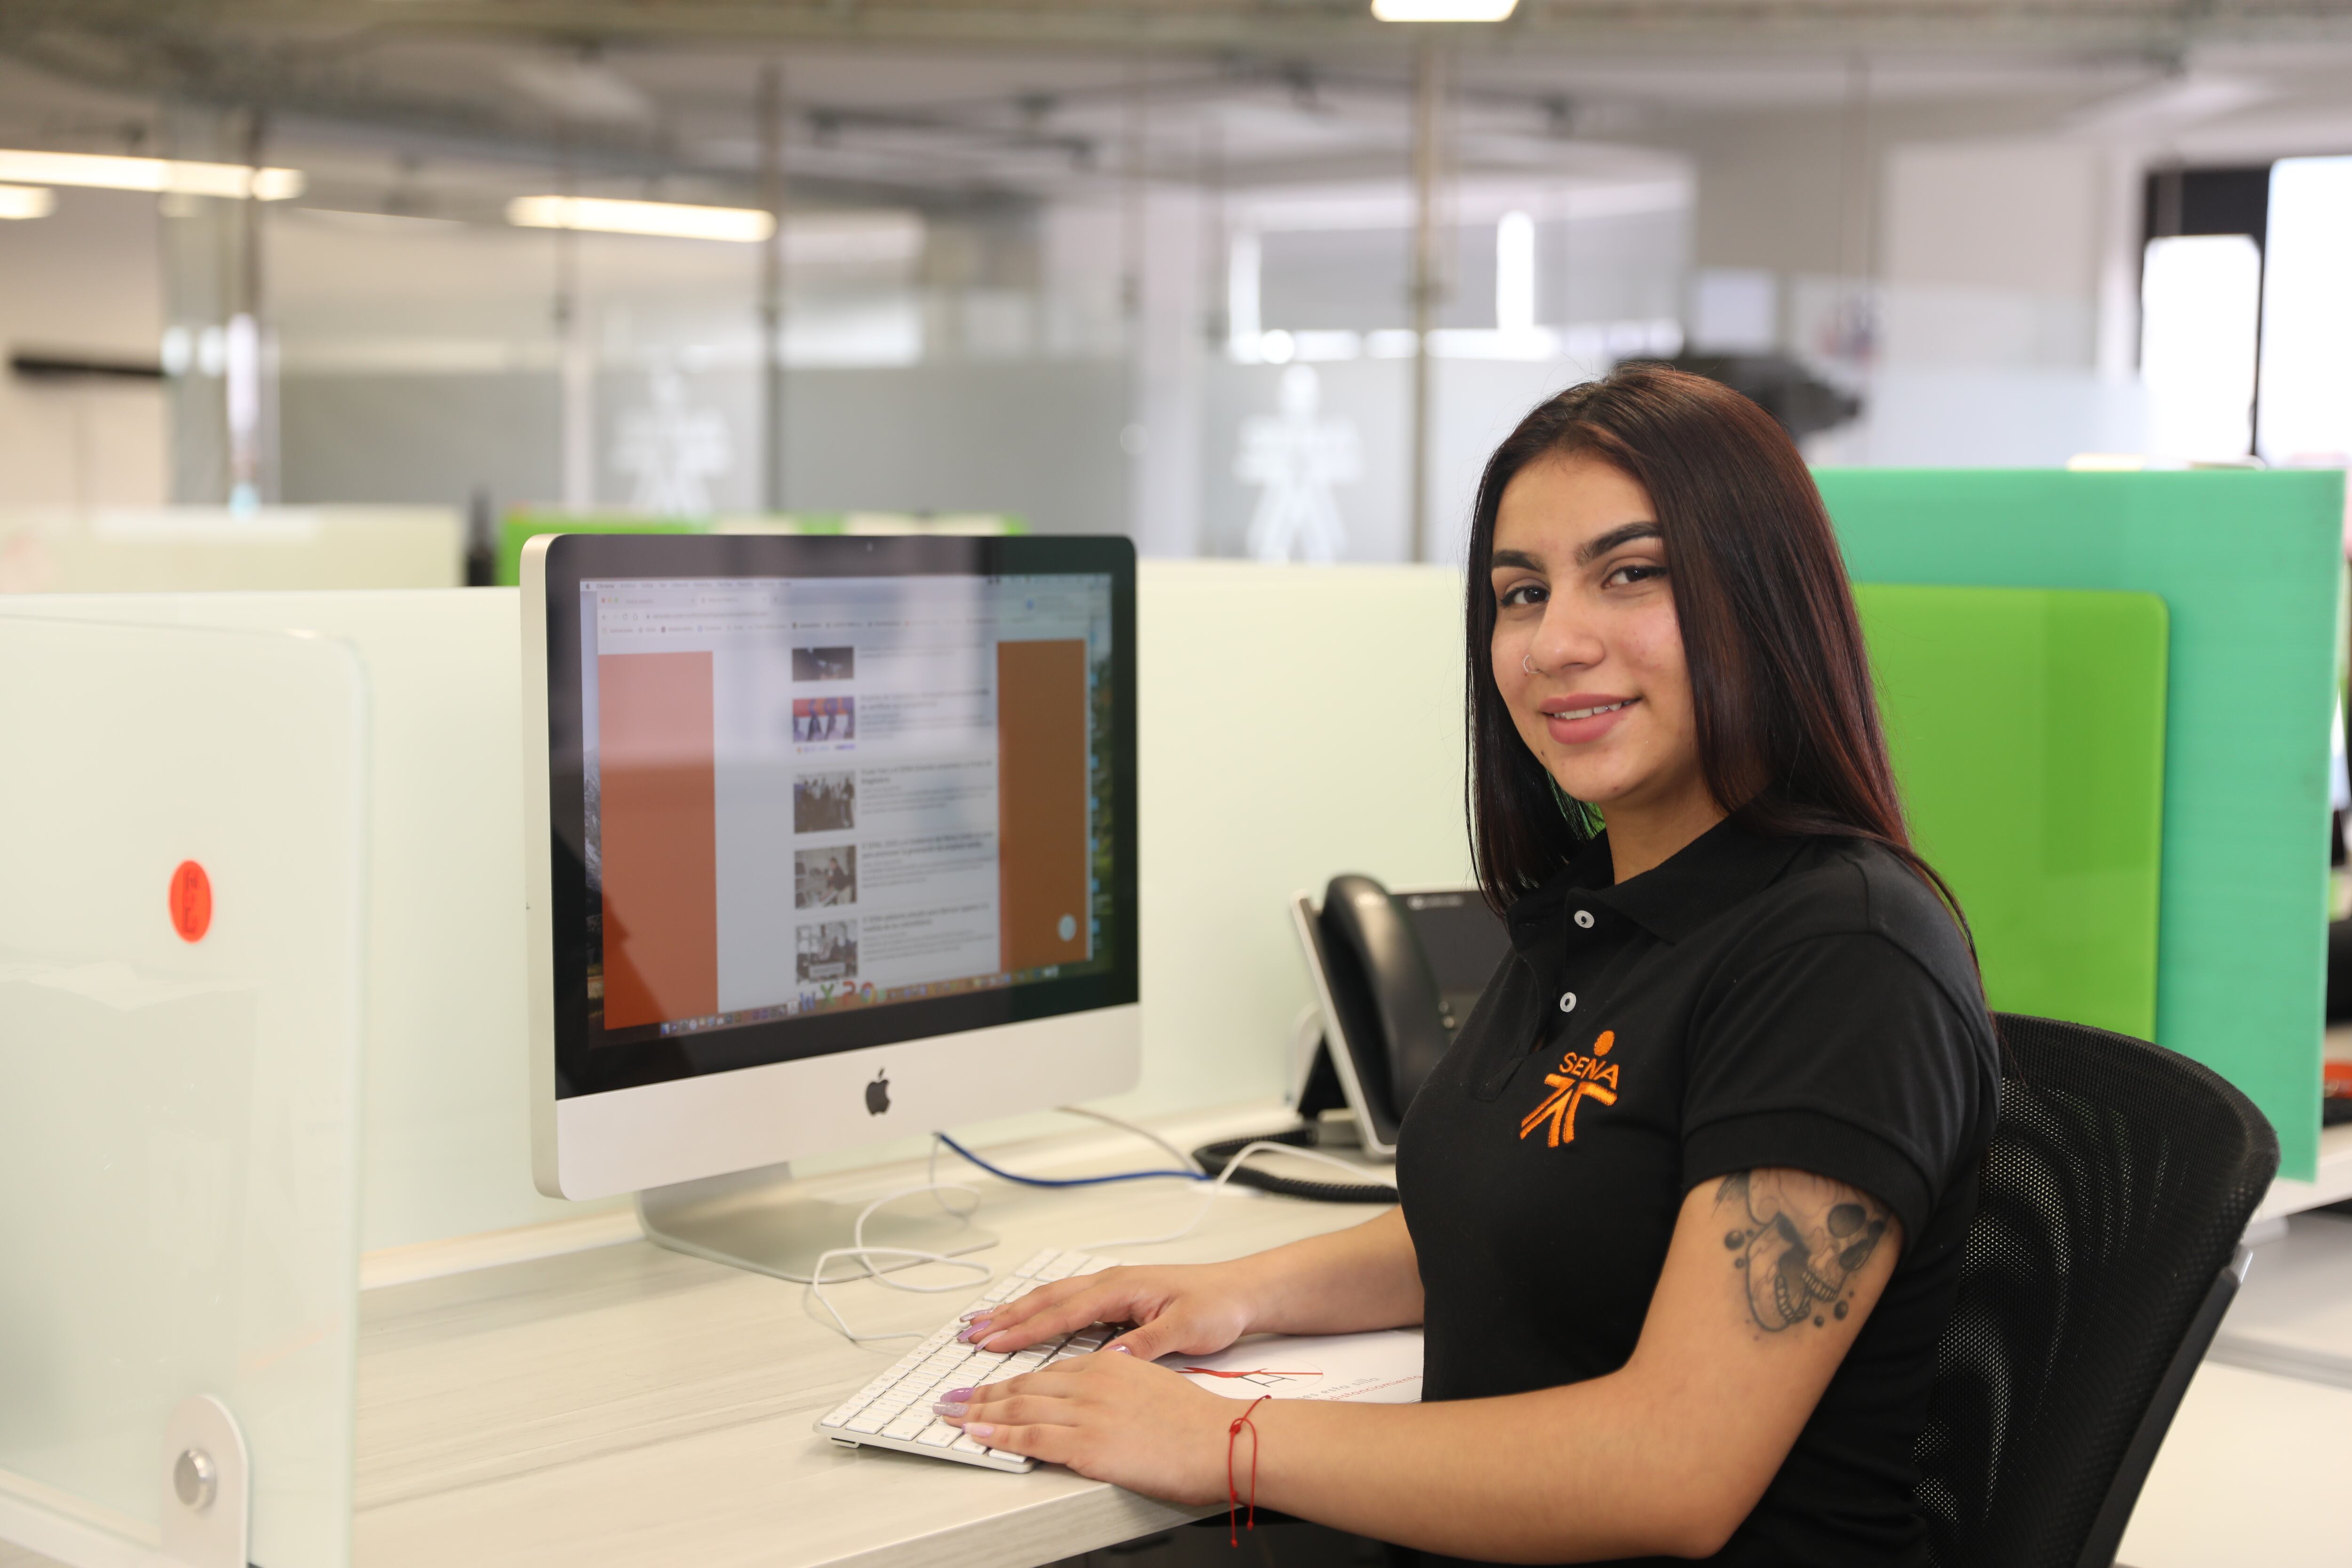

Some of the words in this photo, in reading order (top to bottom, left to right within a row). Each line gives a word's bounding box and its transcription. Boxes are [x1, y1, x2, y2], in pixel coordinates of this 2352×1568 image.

[1559, 1051, 1619, 1090] SENA
[1320, 1385, 1351, 1394] esta
[1351, 1377, 1380, 1387] silla
[1329, 1375, 1422, 1401] distanciamiento
